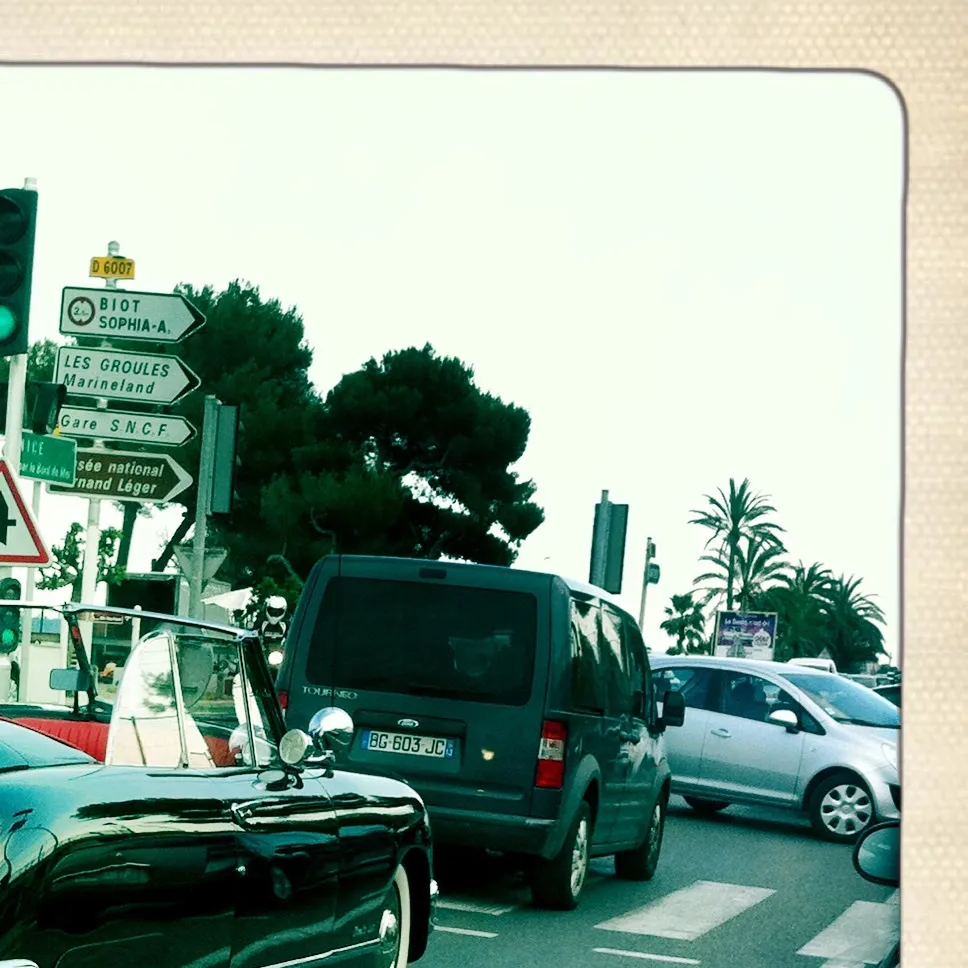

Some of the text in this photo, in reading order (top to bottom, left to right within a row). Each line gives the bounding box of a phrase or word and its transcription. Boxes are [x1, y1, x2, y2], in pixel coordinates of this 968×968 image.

[92, 260, 133, 275] D 6007
[99, 297, 141, 313] BIOT
[64, 355, 171, 378] LES GROULES
[63, 373, 156, 395] Marineland
[61, 414, 97, 430] Gare
[75, 458, 165, 478] sée national
[72, 475, 158, 497] rnand Léger
[302, 686, 358, 700] TOURNEO
